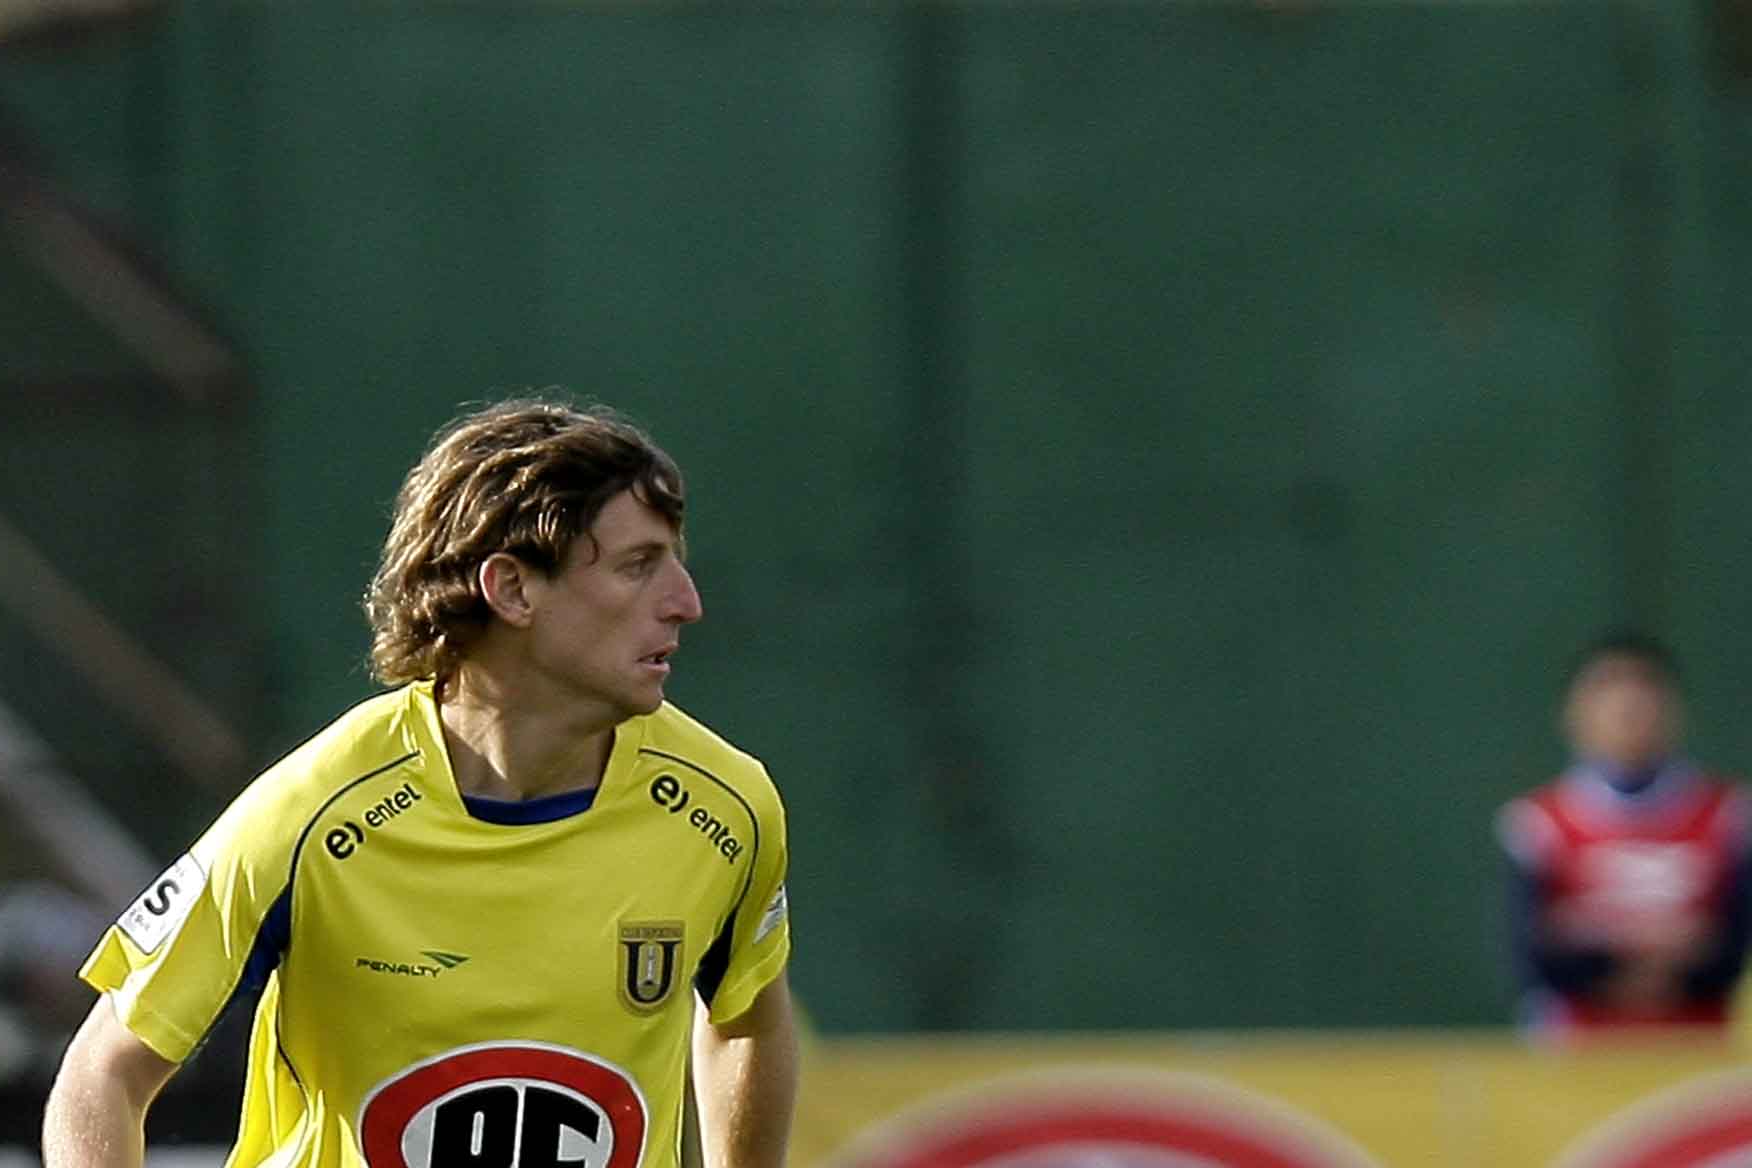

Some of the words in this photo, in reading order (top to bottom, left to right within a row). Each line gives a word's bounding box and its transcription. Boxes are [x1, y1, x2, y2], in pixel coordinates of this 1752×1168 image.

[365, 783, 423, 828] entel
[689, 807, 745, 865] entel
[355, 957, 442, 979] PENALTY
